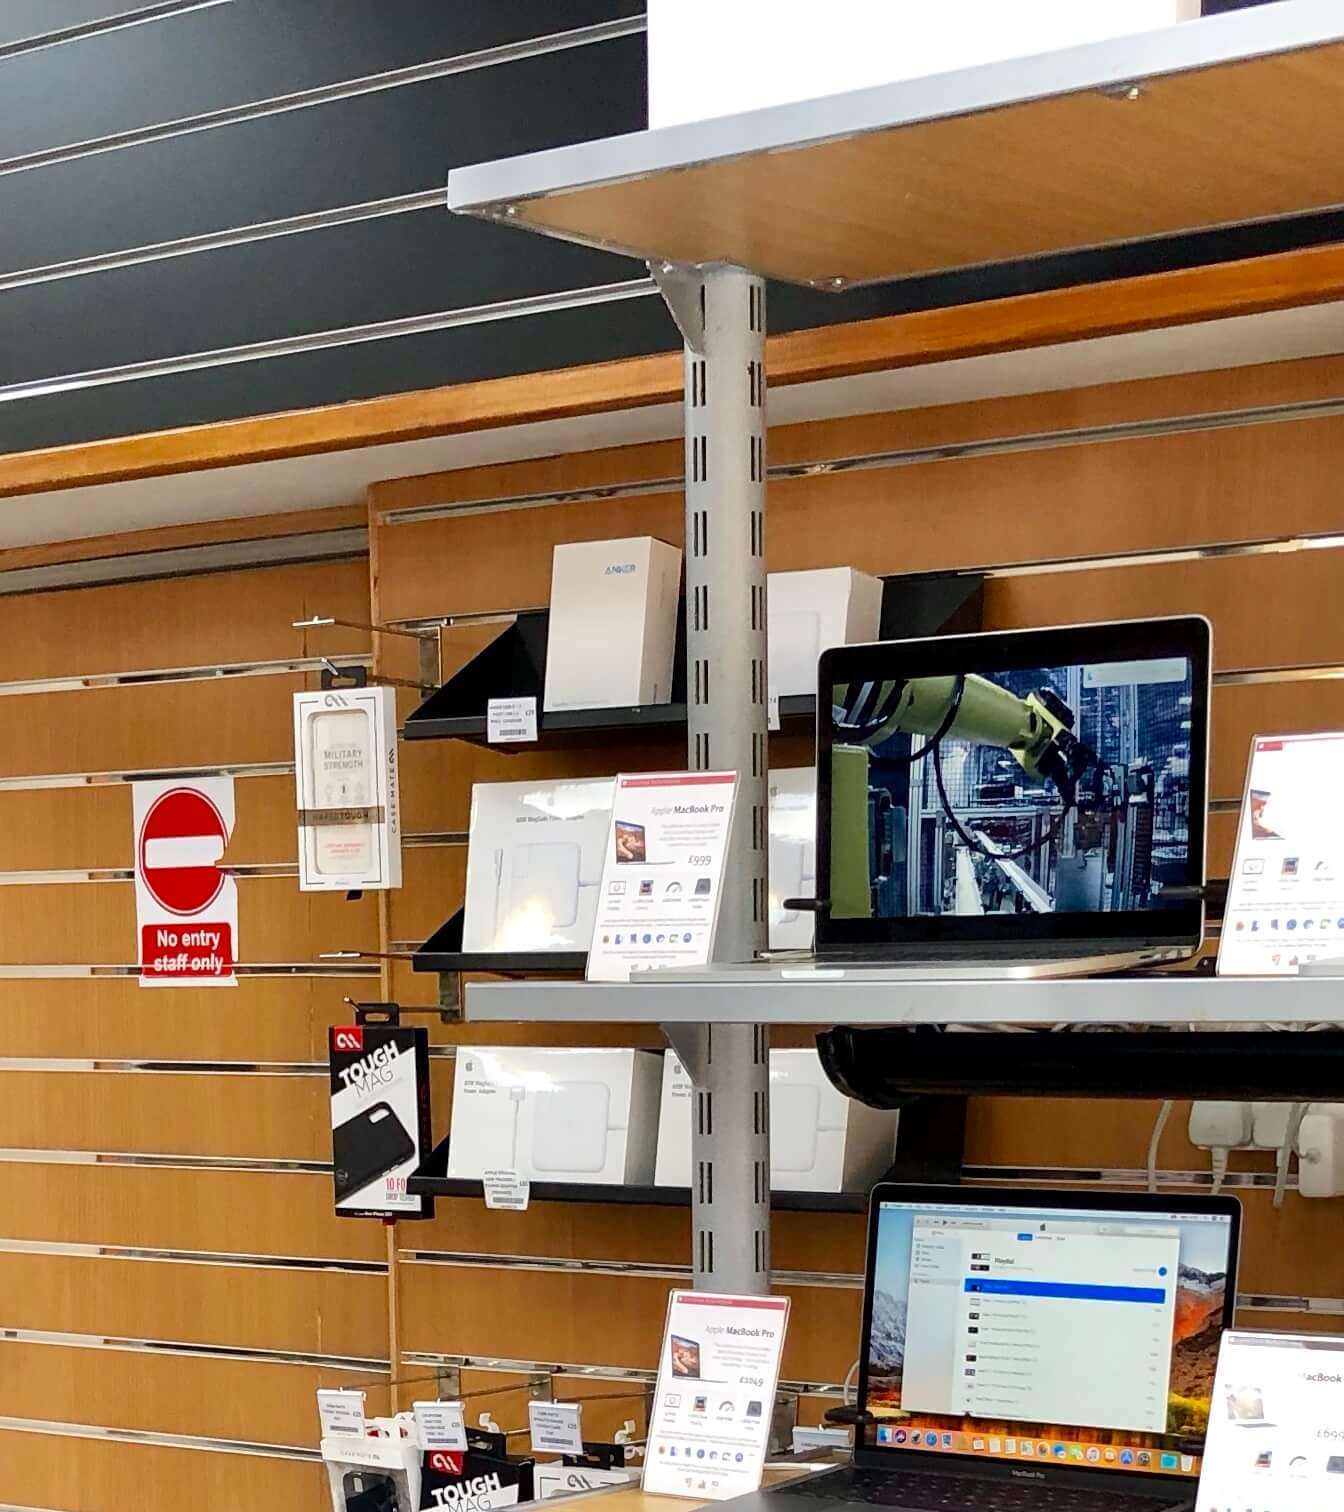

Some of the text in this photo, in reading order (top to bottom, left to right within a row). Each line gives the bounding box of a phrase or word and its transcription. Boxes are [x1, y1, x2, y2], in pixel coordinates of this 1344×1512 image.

[605, 563, 636, 576] ANKER
[324, 749, 362, 760] MILITARY
[323, 760, 364, 771] STRENGTH
[674, 805, 709, 815] MacBook
[710, 803, 726, 814] Pro
[687, 854, 713, 867] £999
[157, 929, 220, 950] No entry
[154, 954, 224, 976] staff only
[338, 1040, 401, 1090] TOUGH
[355, 1065, 394, 1098] MAG
[386, 1177, 396, 1191] 10
[726, 1325, 761, 1339] MacBook
[761, 1328, 776, 1339] Pro
[431, 1472, 501, 1506] TOUGH
